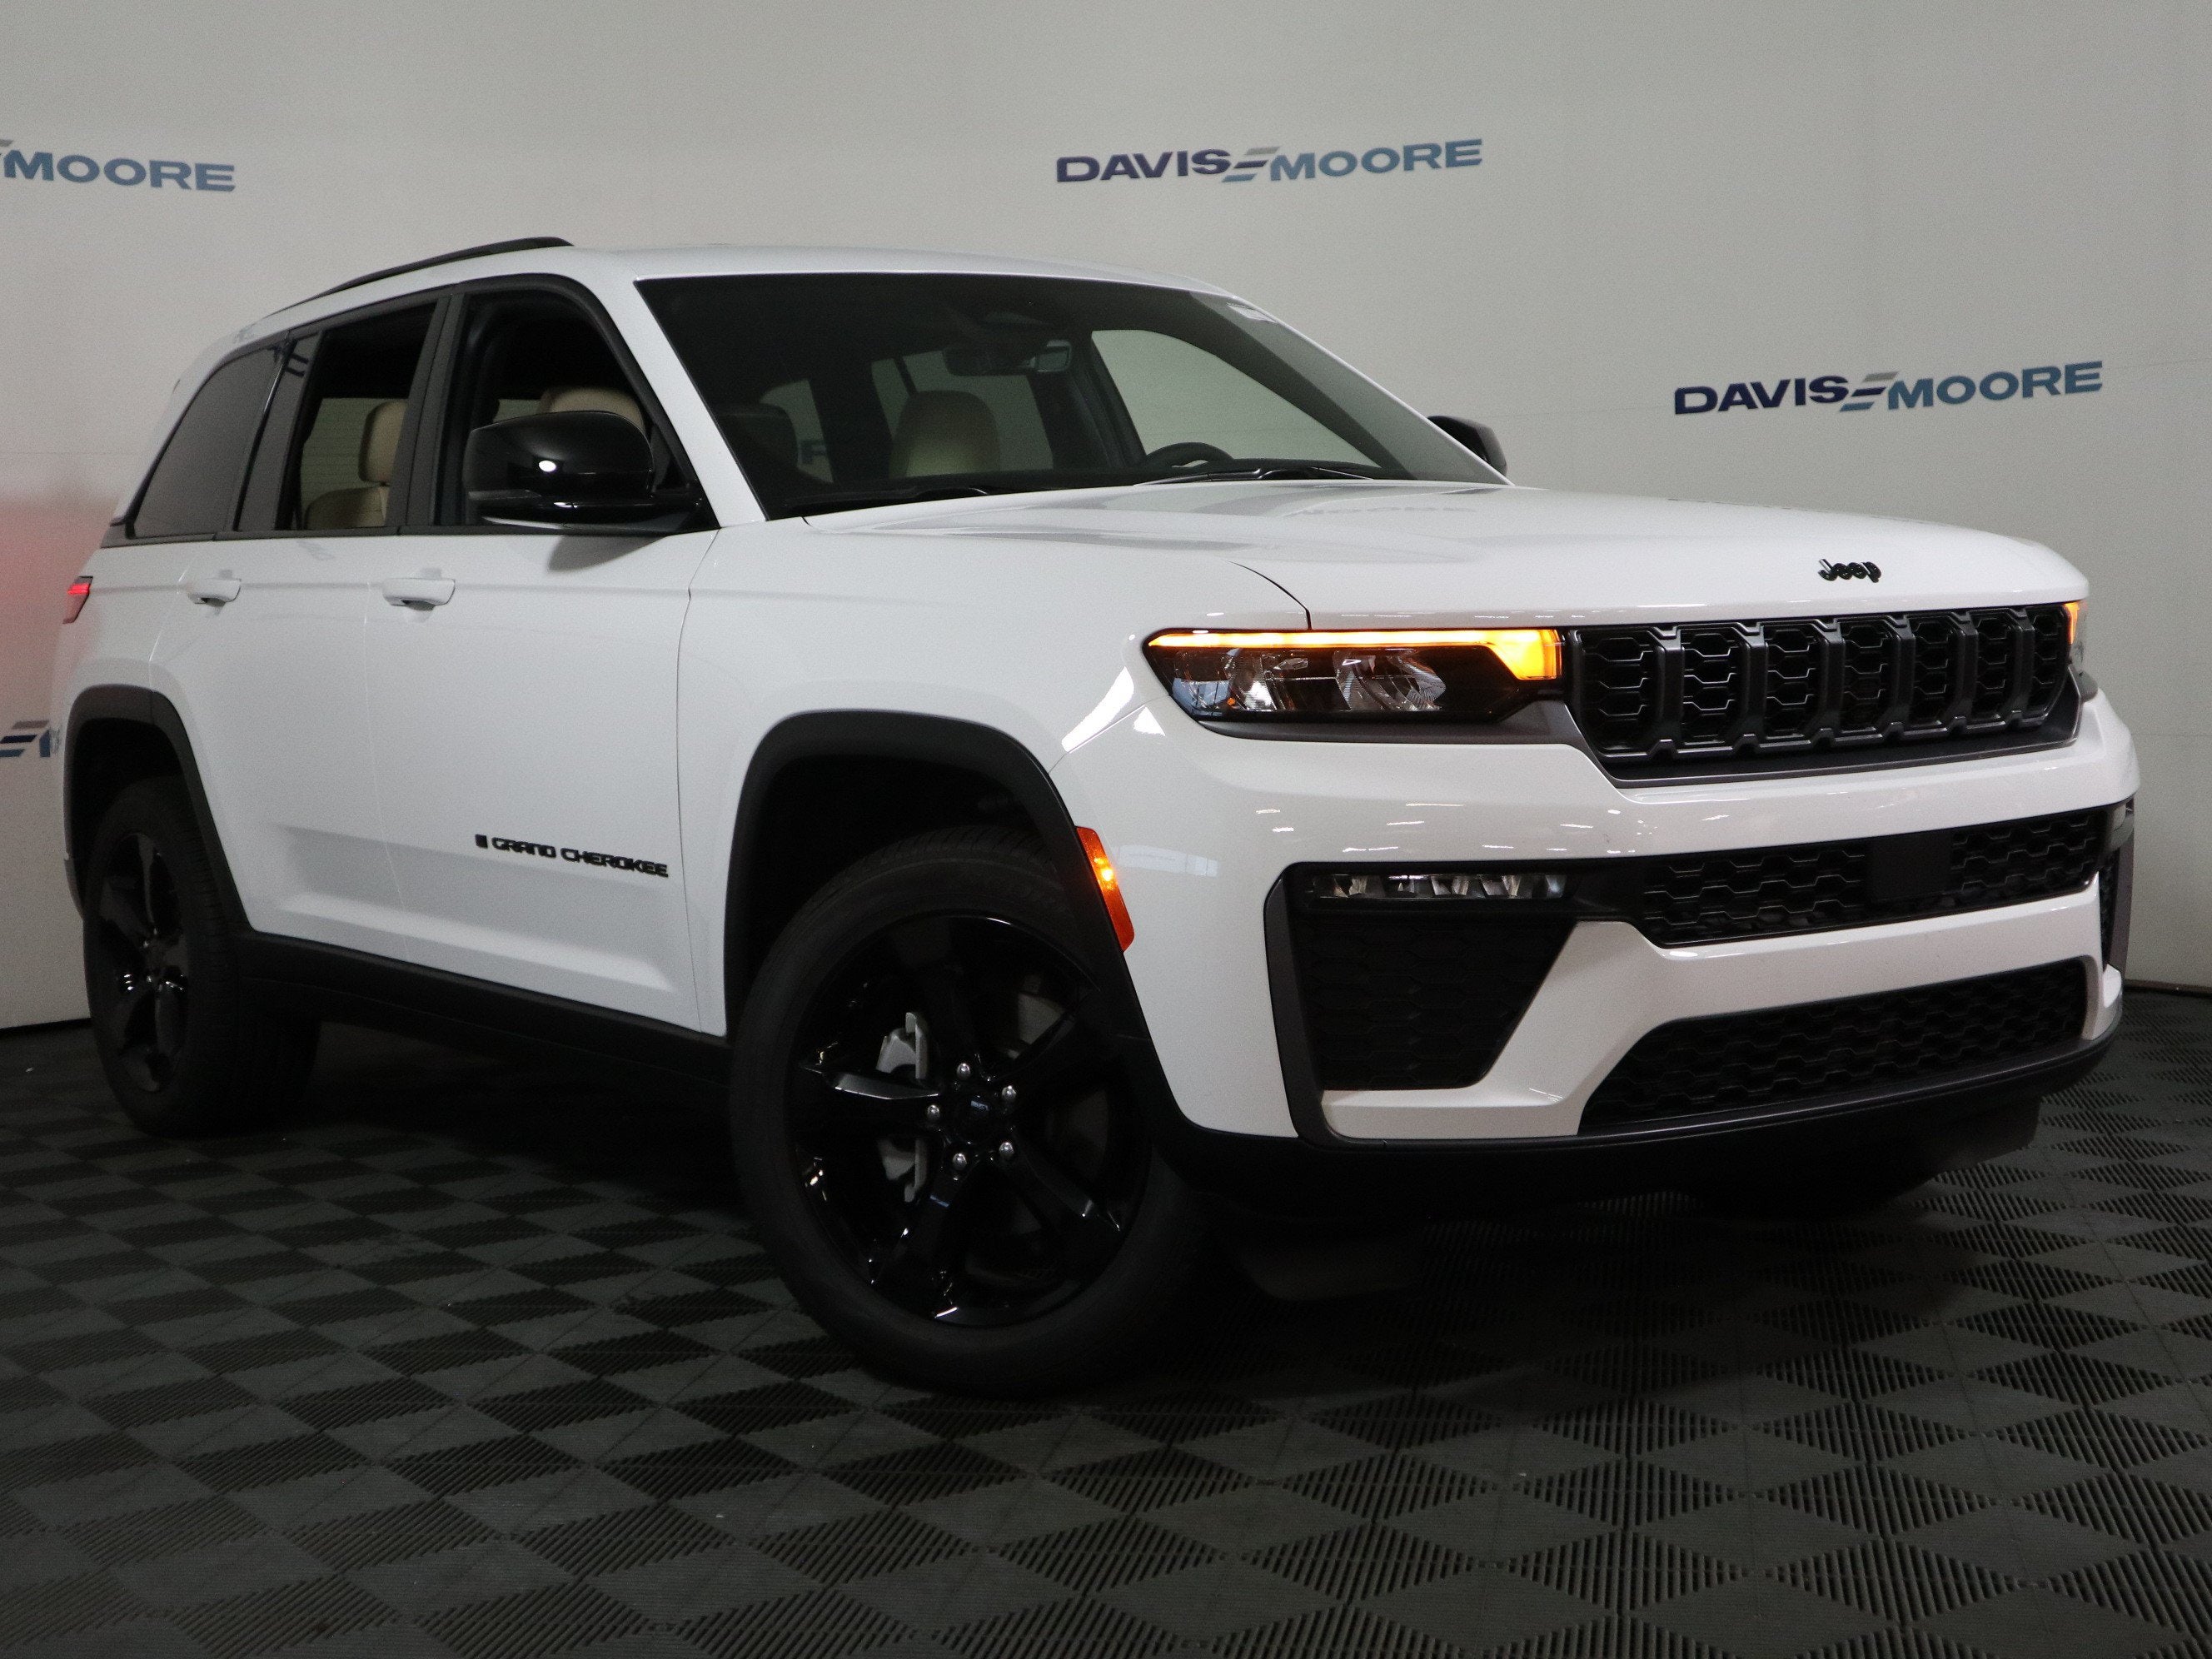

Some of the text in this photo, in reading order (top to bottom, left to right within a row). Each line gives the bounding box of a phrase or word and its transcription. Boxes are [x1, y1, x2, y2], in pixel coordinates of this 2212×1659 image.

[4, 150, 235, 192] MOORE
[1056, 139, 1482, 183] DAVIS MOORE
[1674, 361, 2103, 416] DAVIS MOORE
[1817, 558, 1882, 583] Jeep
[491, 837, 669, 878] GRAND CHEROKEE
